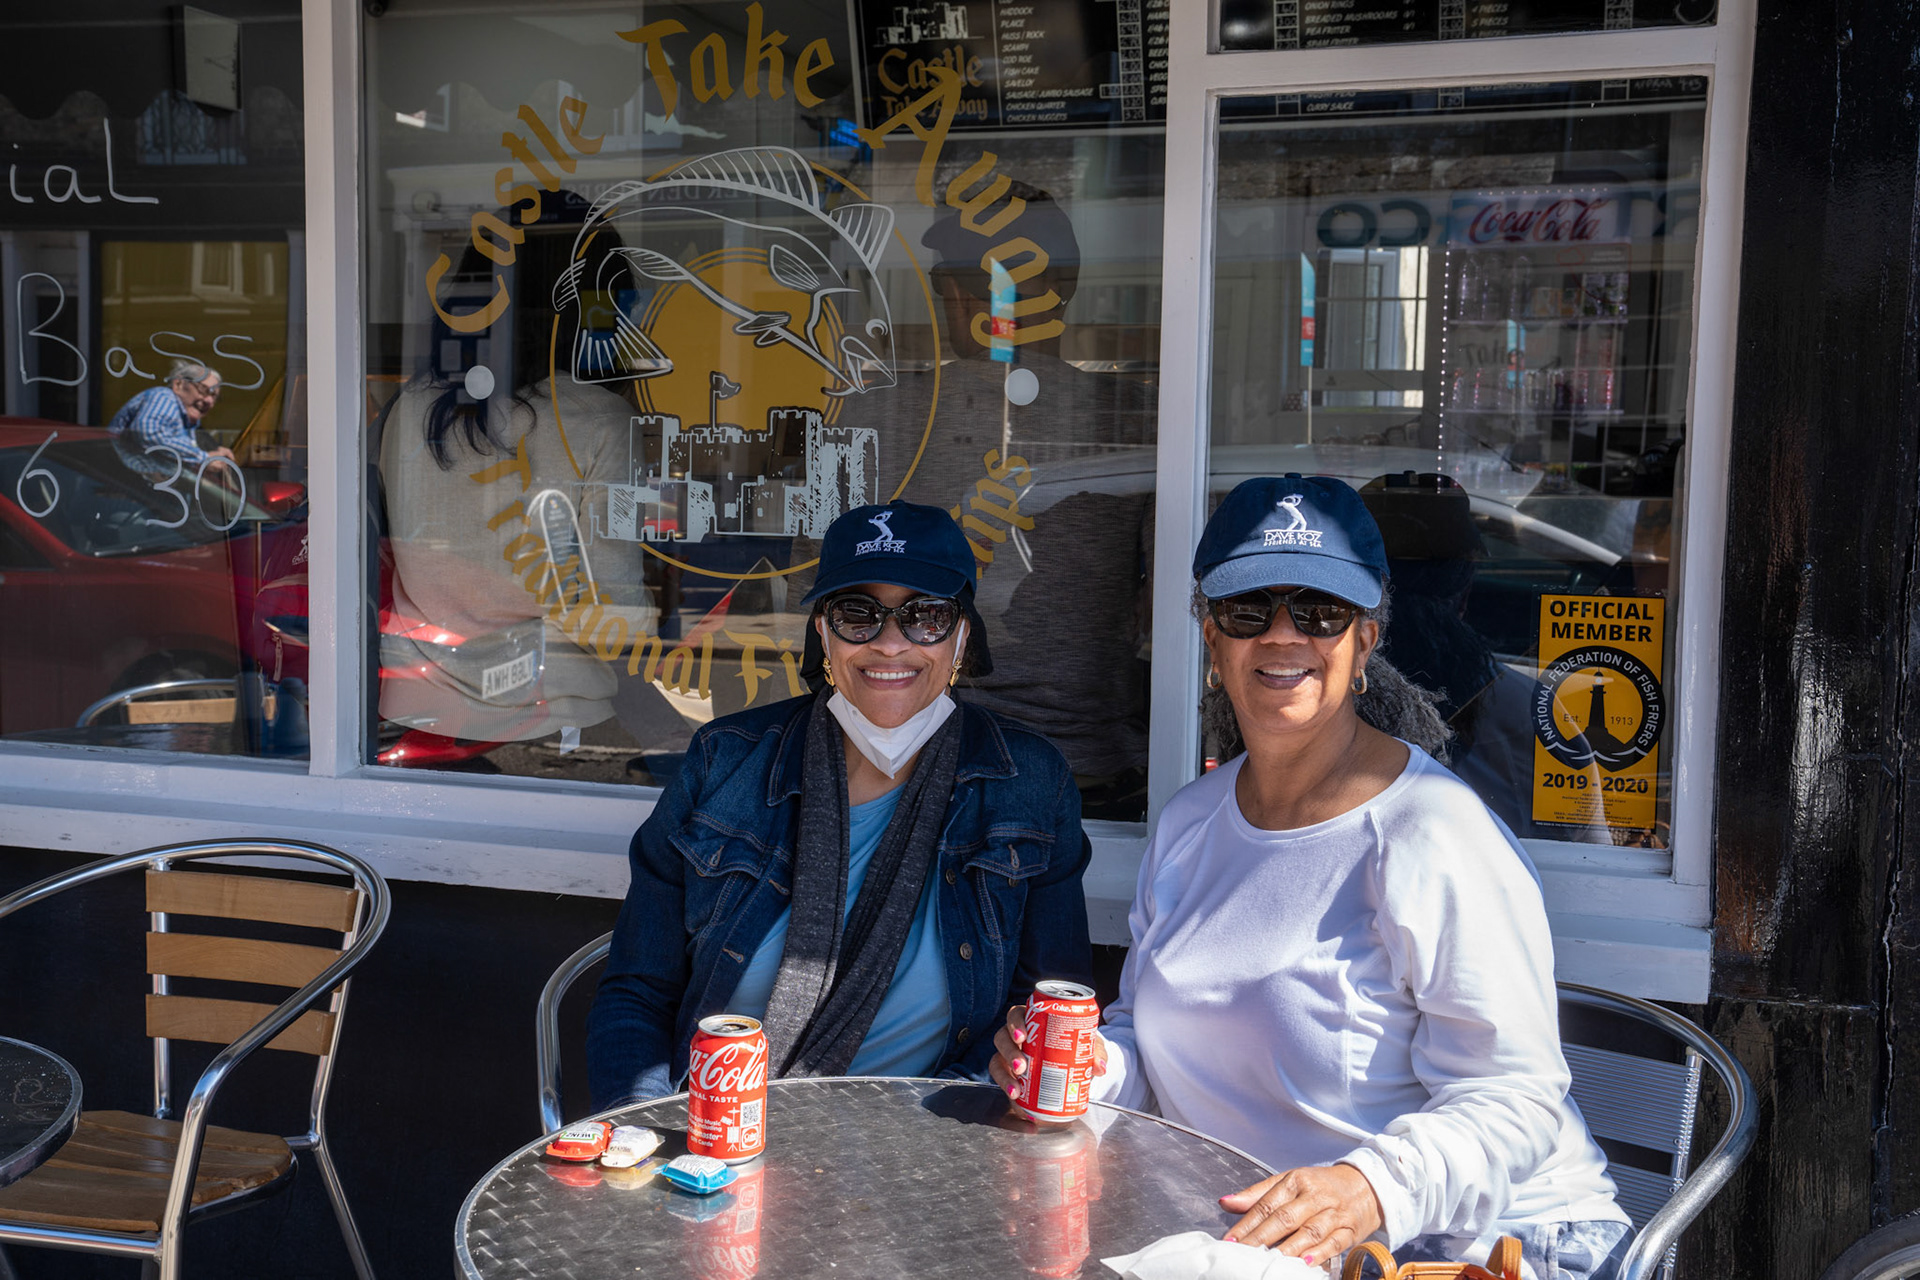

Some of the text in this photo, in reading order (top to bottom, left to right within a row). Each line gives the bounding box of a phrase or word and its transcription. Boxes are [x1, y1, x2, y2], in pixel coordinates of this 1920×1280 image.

[1000, 7, 1034, 16] HADDOCK
[1305, 2, 1329, 11] ONION
[1305, 14, 1343, 24] BREADED
[1344, 10, 1399, 21] MUSHROOMS
[1000, 19, 1025, 28] PLAICE
[1002, 43, 1029, 52] SCAMPI
[1021, 66, 1040, 75] CAKE
[1004, 79, 1035, 88] SAVELOY
[1005, 90, 1036, 99] SAUSAGE
[1005, 103, 1036, 111] CHICKEN
[1329, 101, 1355, 111] SAUCE
[1006, 114, 1037, 122] CHICKEN
[426, 1, 1066, 348] Castle Take Away
[1468, 196, 1609, 245] Coca-Cola
[1265, 531, 1321, 543] DAVE KOZ
[857, 541, 905, 553] DAVE KOZ
[469, 433, 714, 700] Traditional
[723, 629, 812, 708] Fi
[1549, 600, 1655, 621] OFFICIAL
[1551, 621, 1653, 642] MEMBER
[1537, 651, 1660, 747] NATIONAL FEDERATION OF FISH FRIERS
[1563, 713, 1634, 726] Est. 1913
[1542, 772, 1588, 790] 2019
[1602, 776, 1649, 794] 2020
[1052, 1002, 1071, 1013] Coke
[689, 1033, 768, 1093] a-Cola
[709, 1094, 739, 1104] TASTE
[704, 1118, 721, 1127] Music
